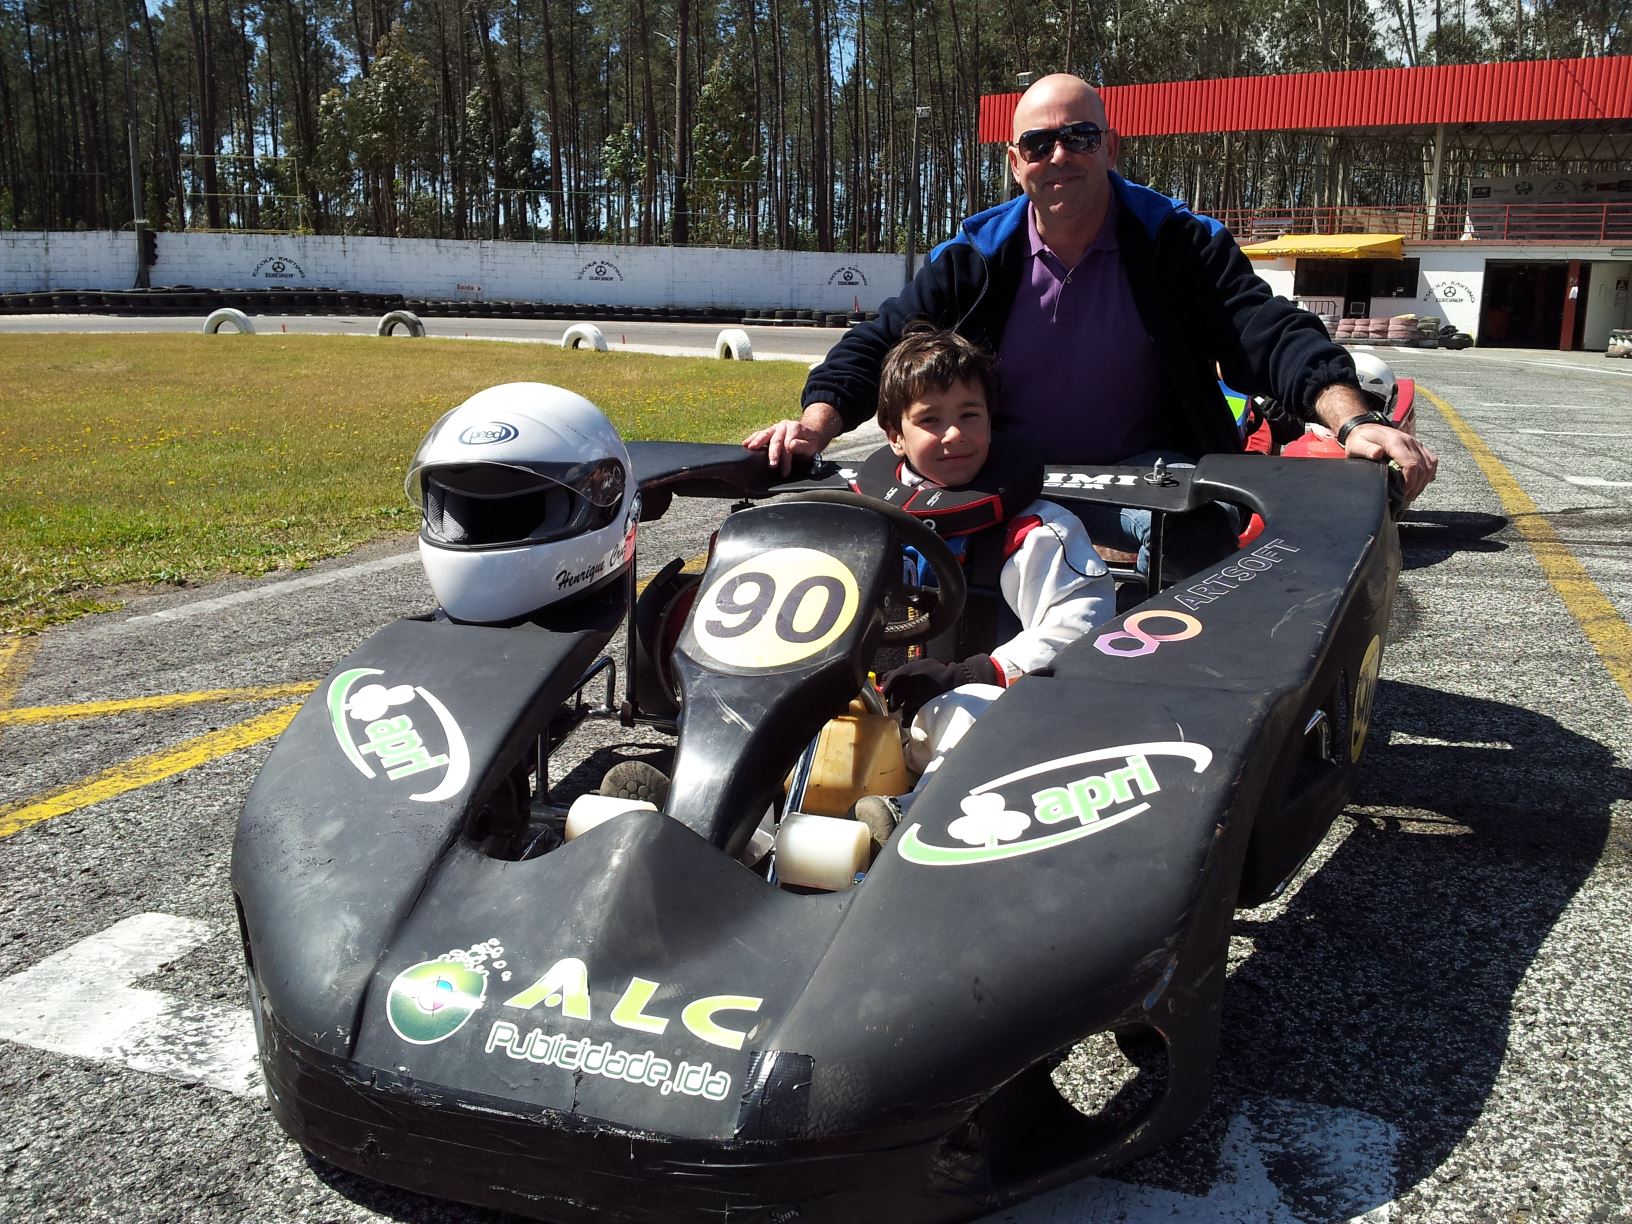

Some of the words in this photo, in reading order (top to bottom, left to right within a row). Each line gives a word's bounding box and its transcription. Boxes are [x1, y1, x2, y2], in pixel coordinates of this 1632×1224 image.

[252, 256, 274, 277] ESCOLA
[278, 256, 306, 279] KARTING
[601, 261, 624, 281] KARTING
[1451, 281, 1475, 303] KARTING
[555, 560, 605, 590] Henrique
[705, 571, 847, 644] 90
[1174, 538, 1300, 611] ARTSOFT
[358, 714, 450, 781] apri
[1031, 754, 1161, 825] apri
[503, 957, 764, 1051] ALC
